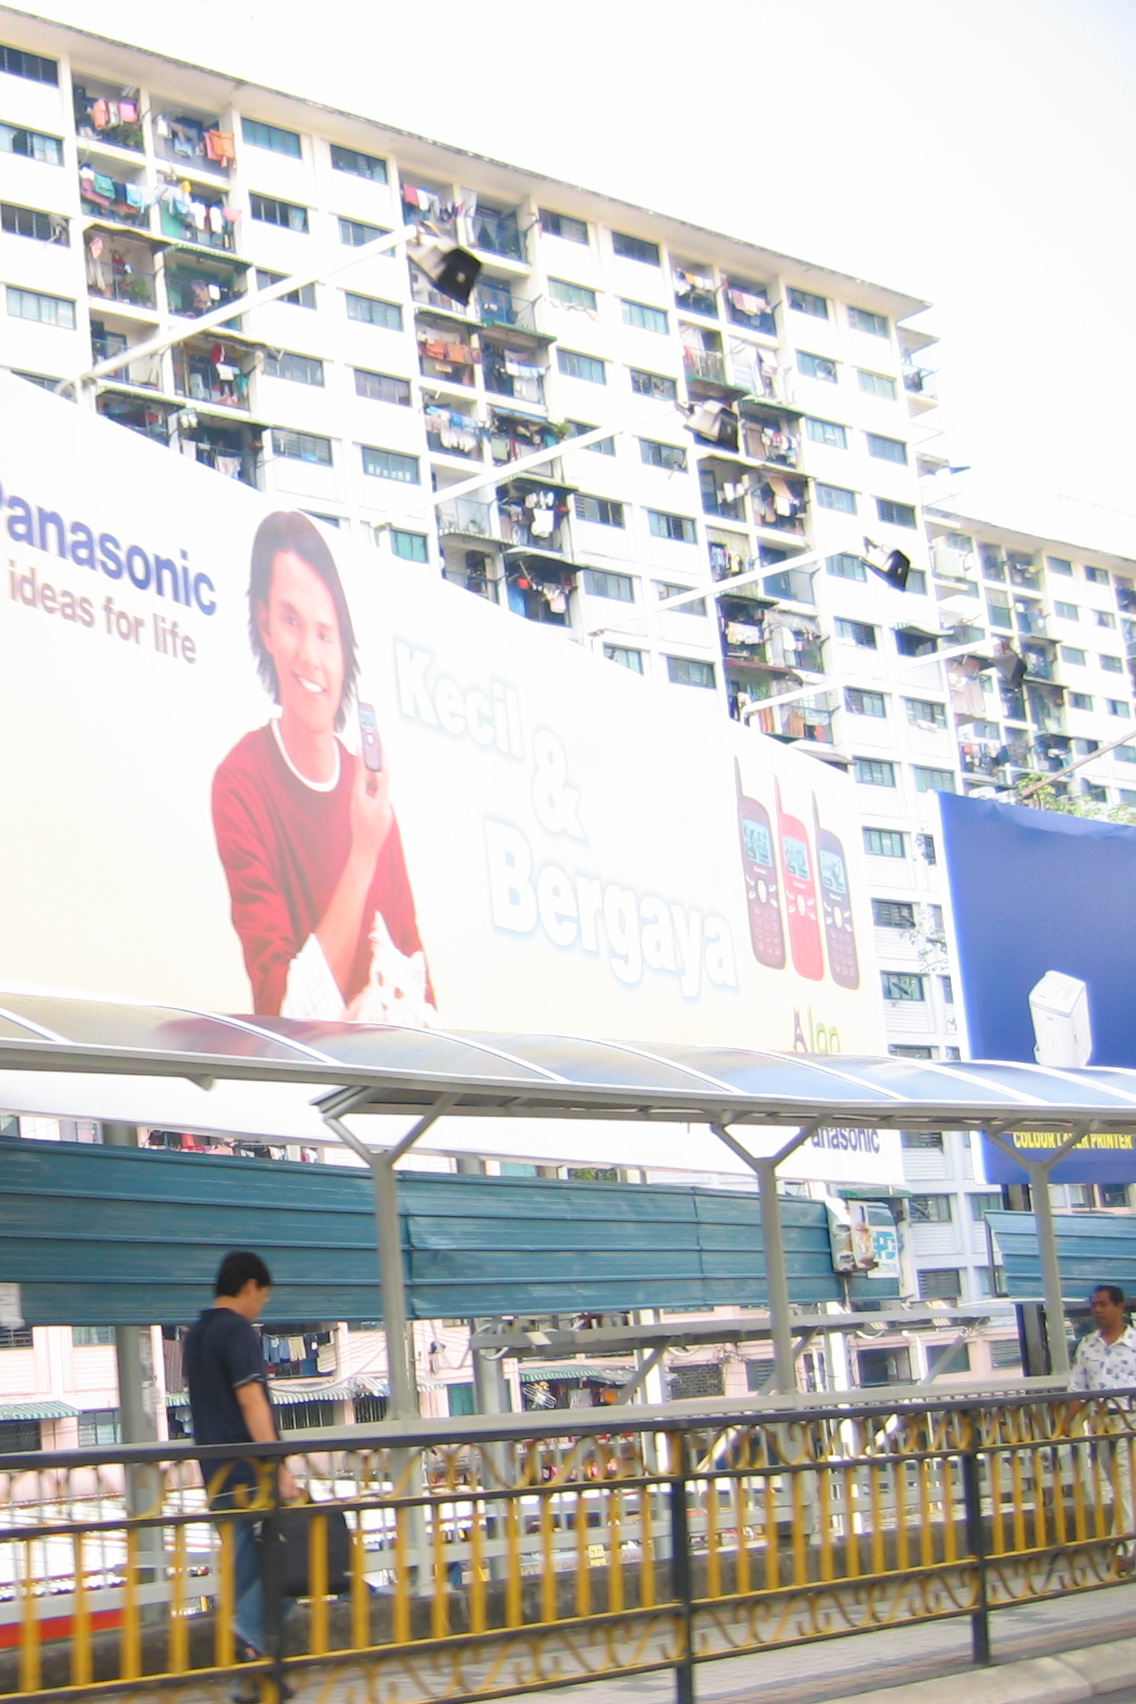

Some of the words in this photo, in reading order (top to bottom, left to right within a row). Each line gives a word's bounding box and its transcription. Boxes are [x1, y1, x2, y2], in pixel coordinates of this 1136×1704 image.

[8, 558, 95, 628] ideas
[102, 595, 145, 645] for
[152, 612, 197, 664] life
[394, 635, 525, 760] Kecil
[532, 725, 589, 843] &
[484, 814, 740, 1000] Bergaya
[802, 1127, 880, 1154] anasonic
[1013, 1131, 1056, 1149] COLOUR
[1090, 1133, 1133, 1149] PRINTER
